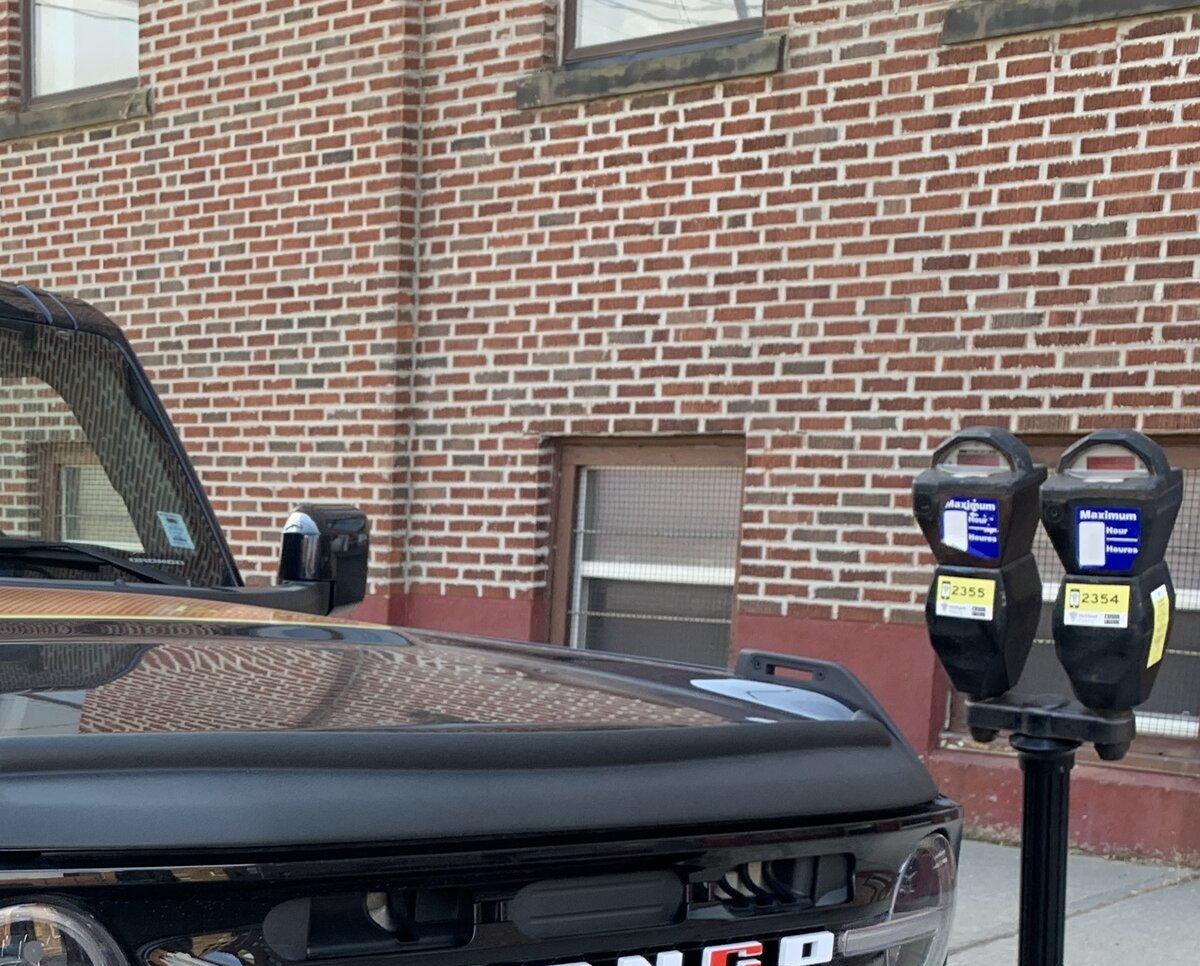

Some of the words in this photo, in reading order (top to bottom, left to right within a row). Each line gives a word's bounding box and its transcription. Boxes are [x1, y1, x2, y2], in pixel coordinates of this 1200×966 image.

[945, 499, 996, 511] Maximum
[968, 516, 988, 524] Hour
[1080, 510, 1137, 521] Maximum
[1106, 527, 1128, 535] Hour
[952, 585, 985, 598] 2355
[1082, 593, 1119, 604] 2354
